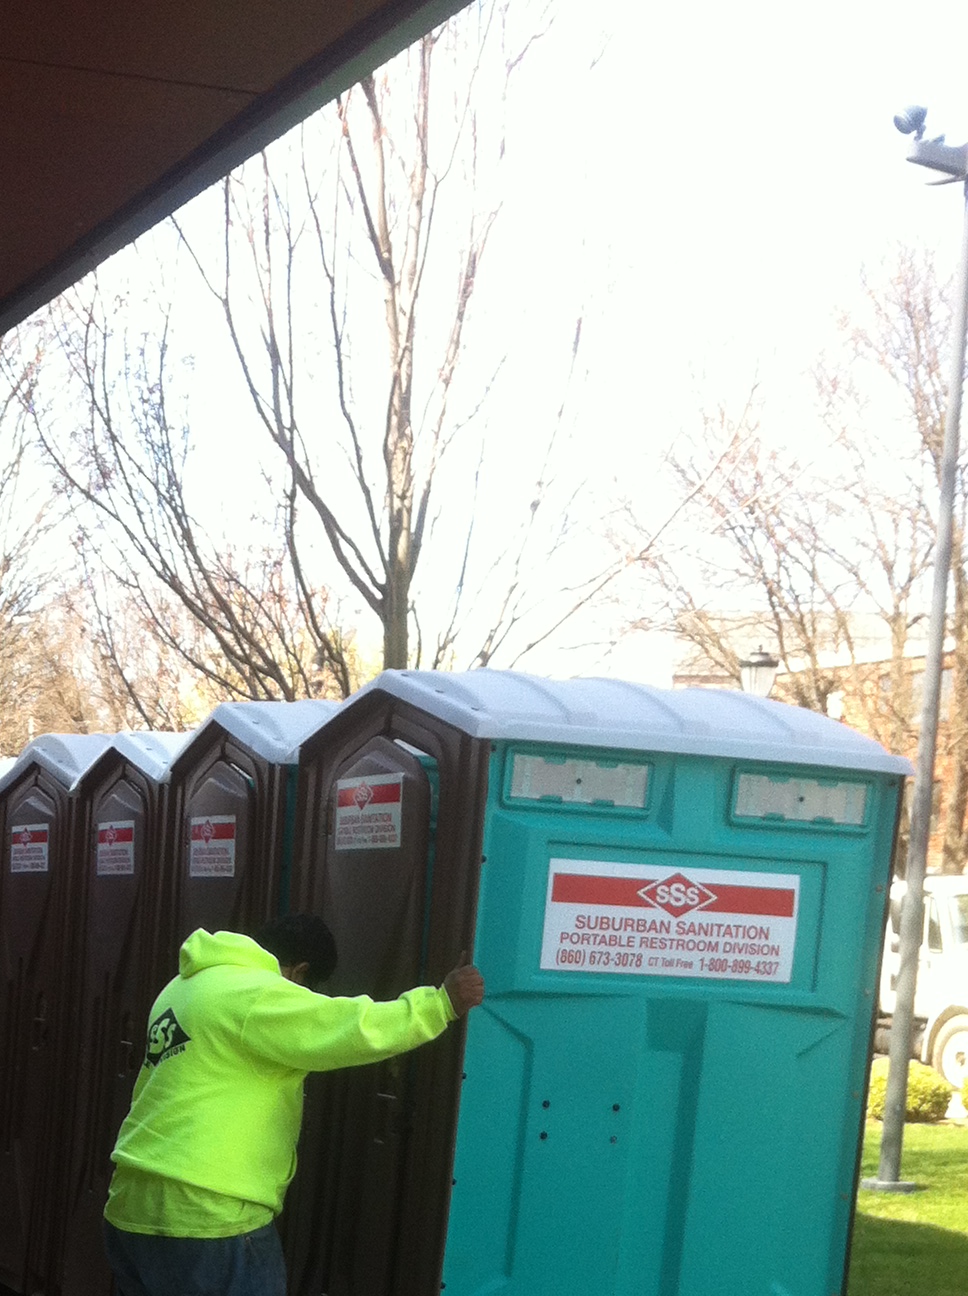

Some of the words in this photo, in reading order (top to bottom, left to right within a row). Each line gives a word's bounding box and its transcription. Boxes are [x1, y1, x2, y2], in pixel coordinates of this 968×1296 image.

[656, 883, 700, 907] SSS
[575, 914, 671, 934] SUBURBAN
[675, 920, 770, 941] SANITATION
[560, 931, 635, 948] PORTABLE
[639, 936, 719, 953] RESTROOM
[722, 941, 780, 957] DIVISION
[555, 948, 586, 967] (860)
[589, 950, 644, 968] 673-3078
